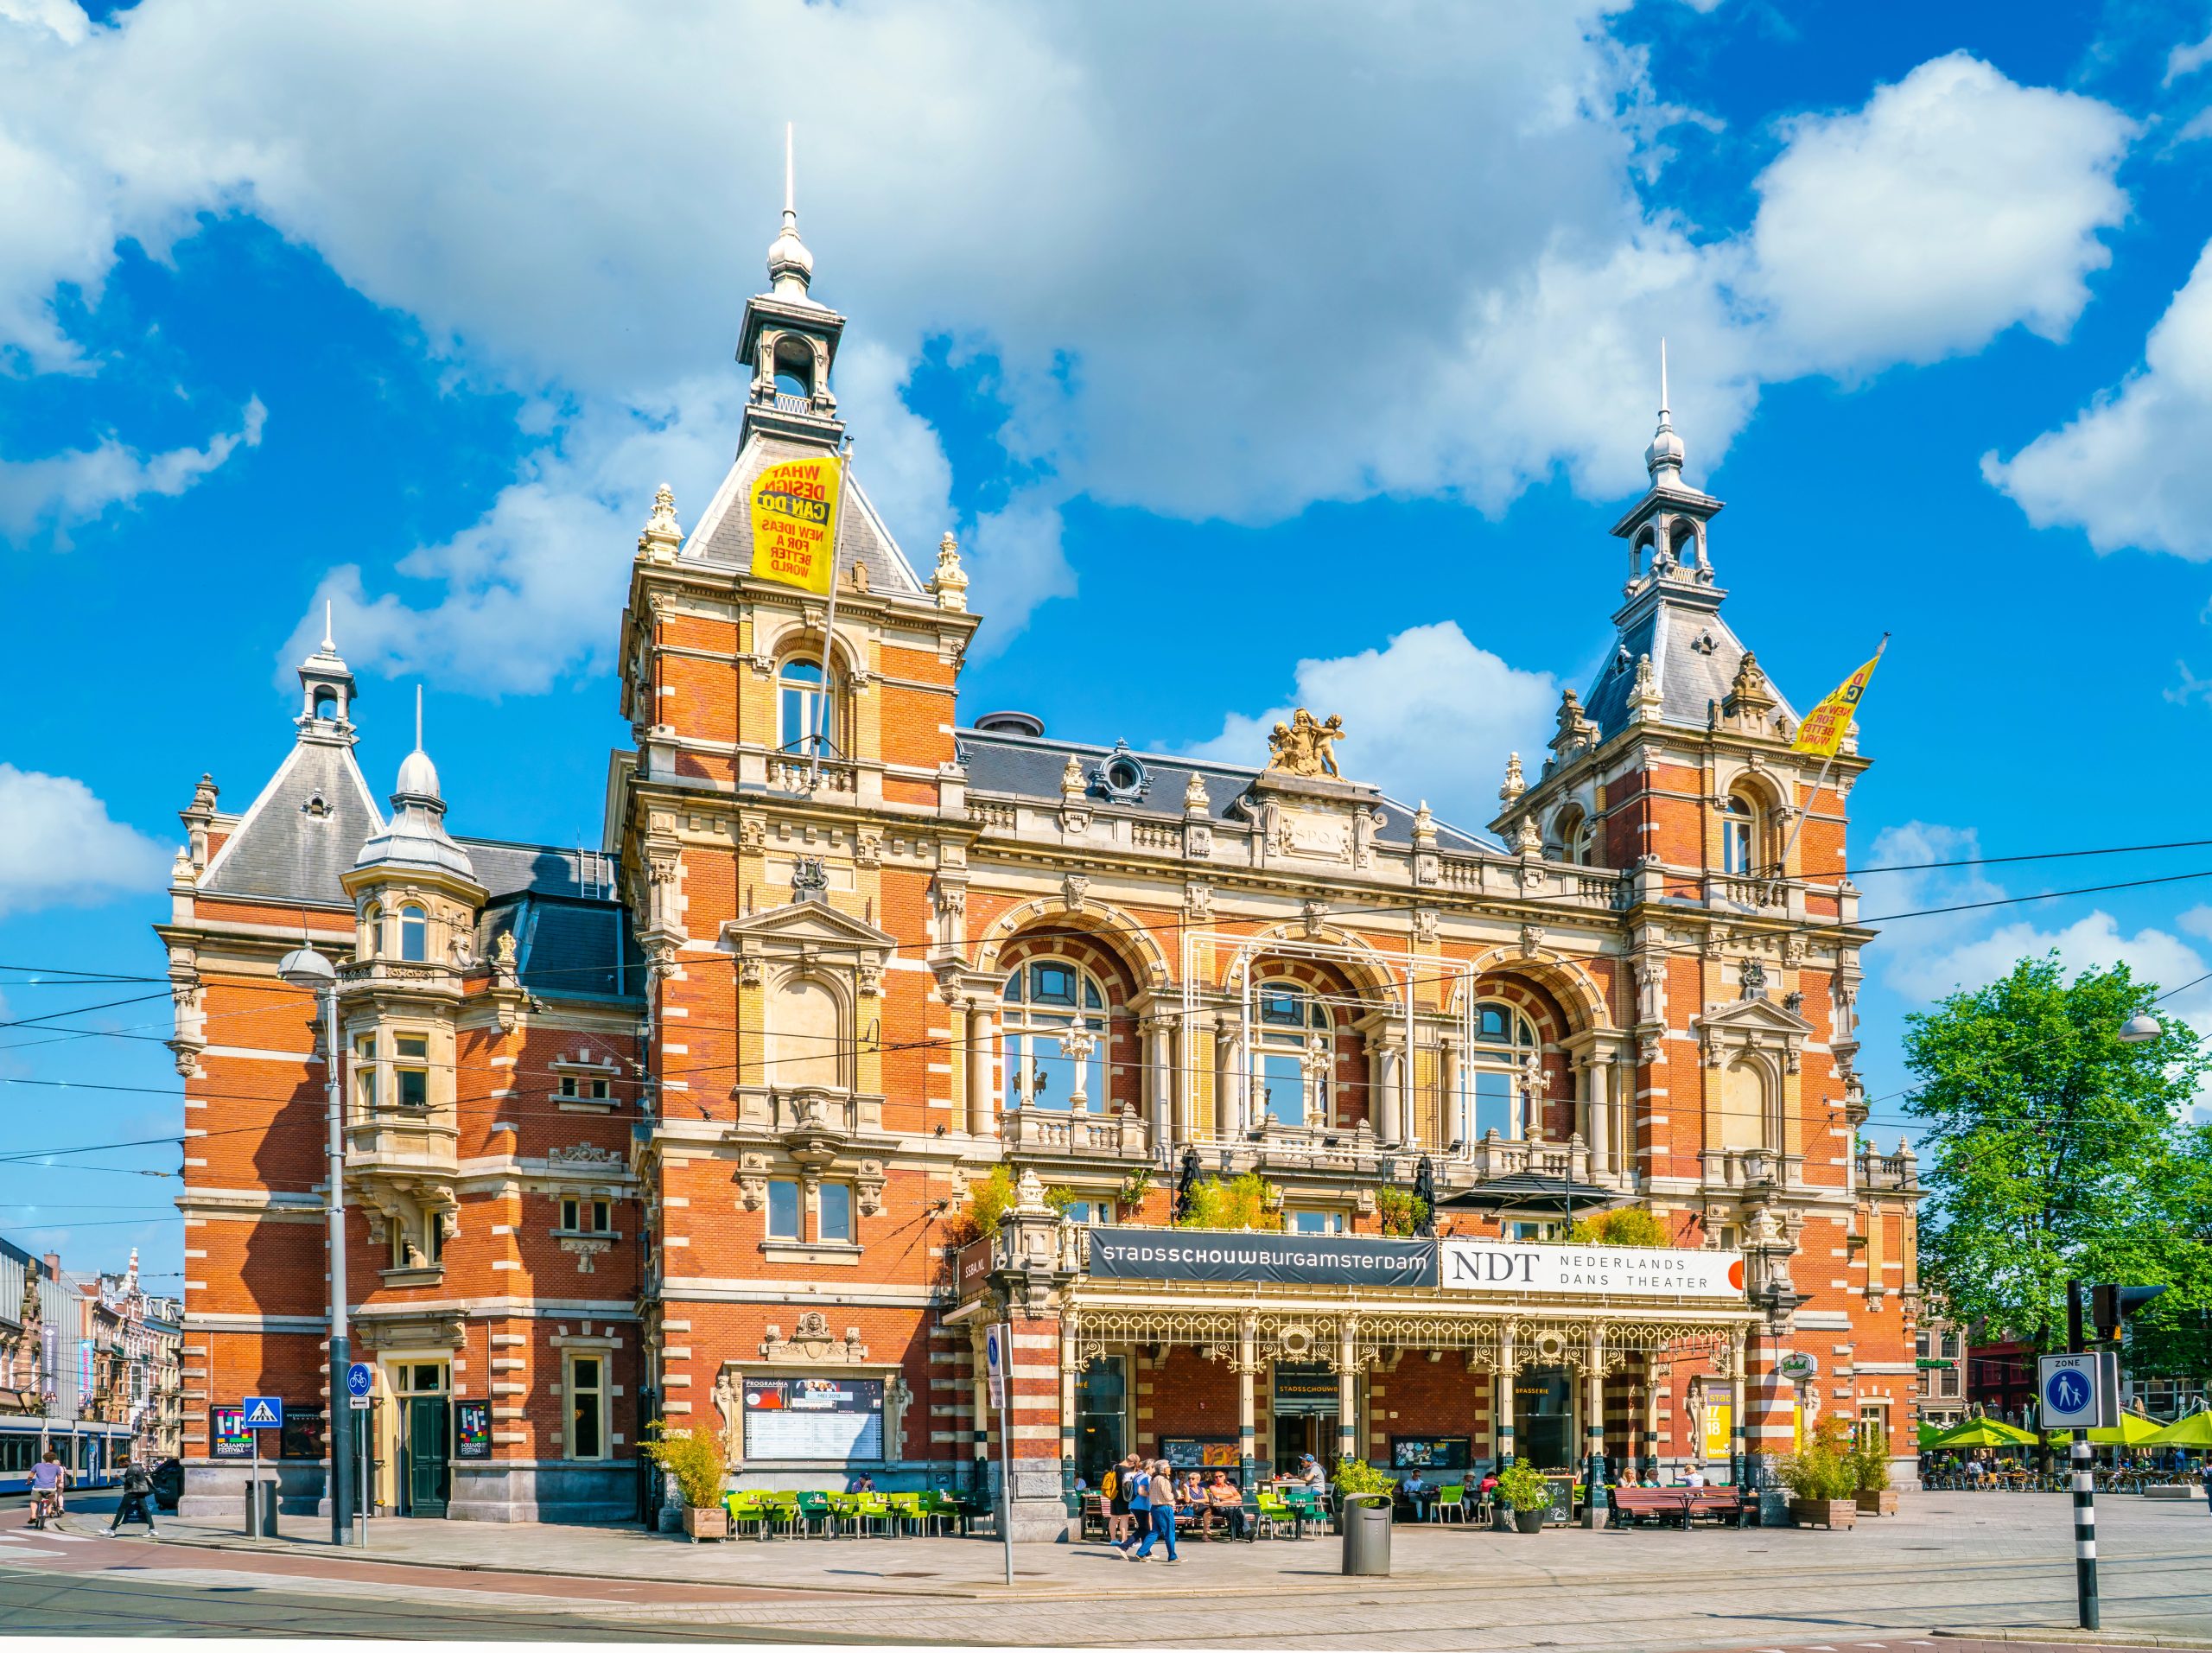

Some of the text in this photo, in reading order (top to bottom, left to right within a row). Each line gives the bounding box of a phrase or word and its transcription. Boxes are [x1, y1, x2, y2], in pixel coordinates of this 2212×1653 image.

[1452, 1250, 1540, 1282] NDT
[1560, 1256, 1685, 1270] NEDERLANDS
[1560, 1274, 1707, 1288] DANS THEATER
[1707, 1406, 1720, 1418] 17
[1707, 1421, 1721, 1435] 18
